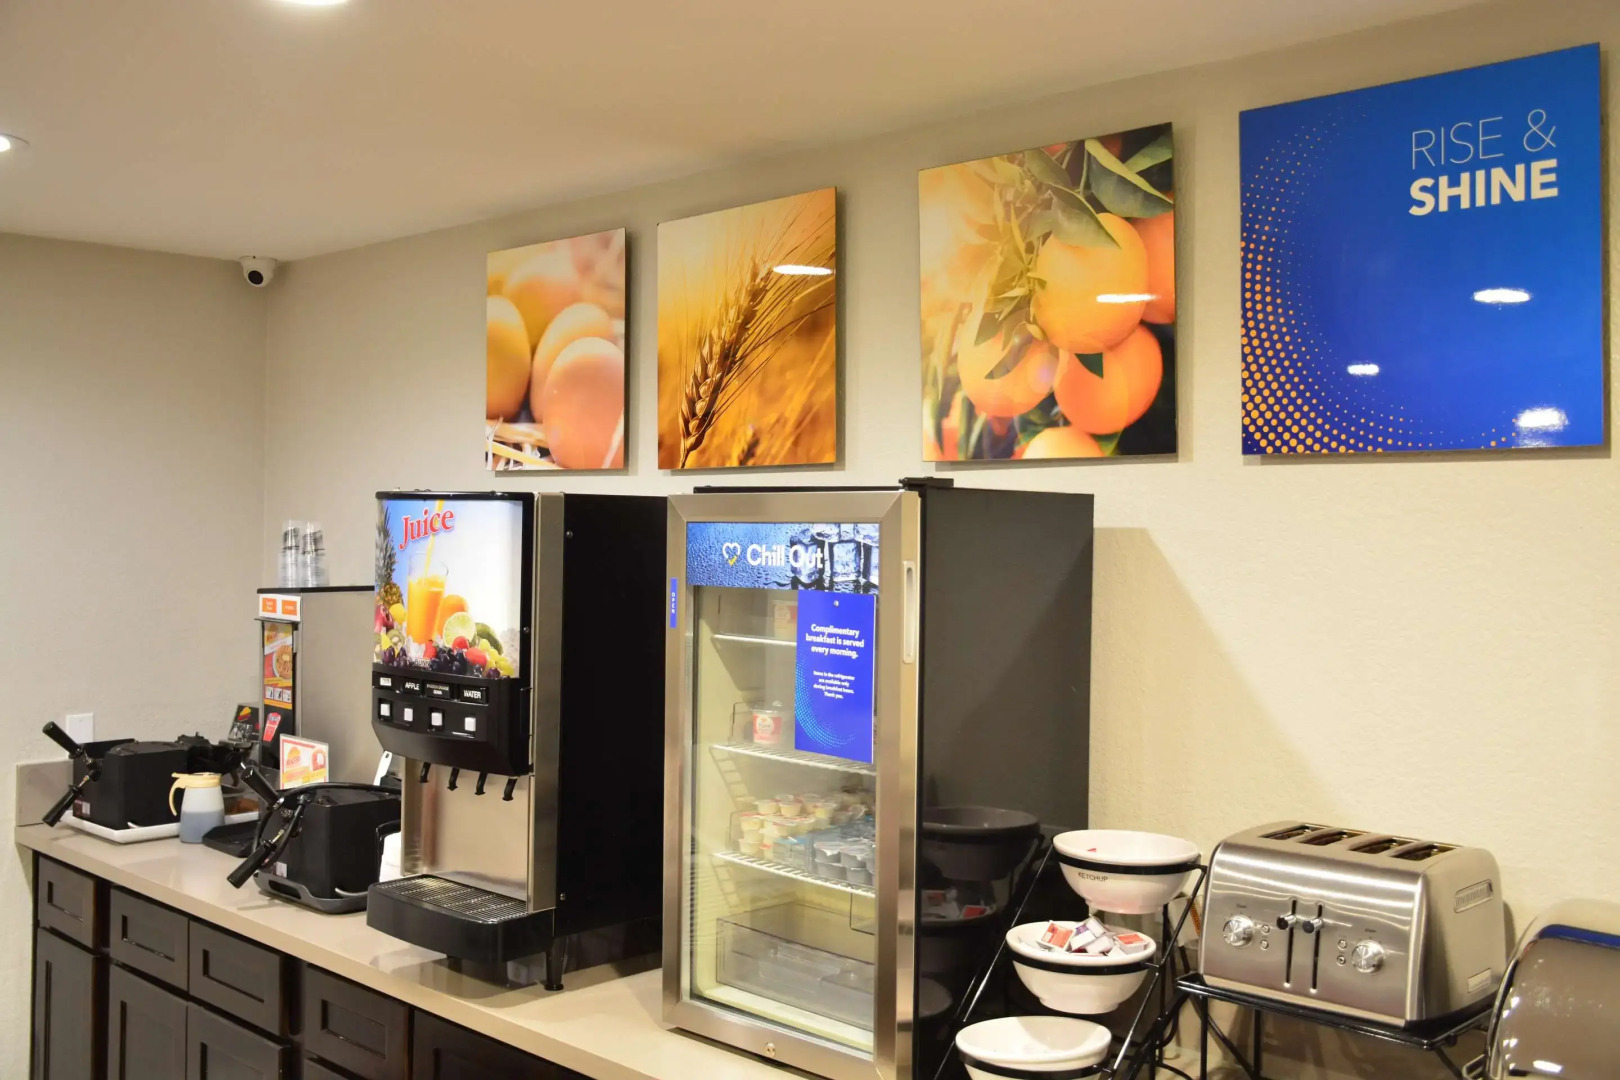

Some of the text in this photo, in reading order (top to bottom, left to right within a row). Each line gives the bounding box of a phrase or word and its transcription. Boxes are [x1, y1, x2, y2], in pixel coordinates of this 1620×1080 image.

[1412, 109, 1556, 170] RISE &
[1408, 158, 1559, 216] SHINE
[399, 508, 454, 549] Juice
[746, 543, 823, 569] Chill Out
[810, 623, 860, 639] Complimentary
[805, 632, 865, 648] breakfast is served
[810, 645, 859, 659] every morning.
[405, 681, 420, 691] APPLE
[463, 689, 482, 699] WATER
[1078, 872, 1109, 882] KETCHUP
